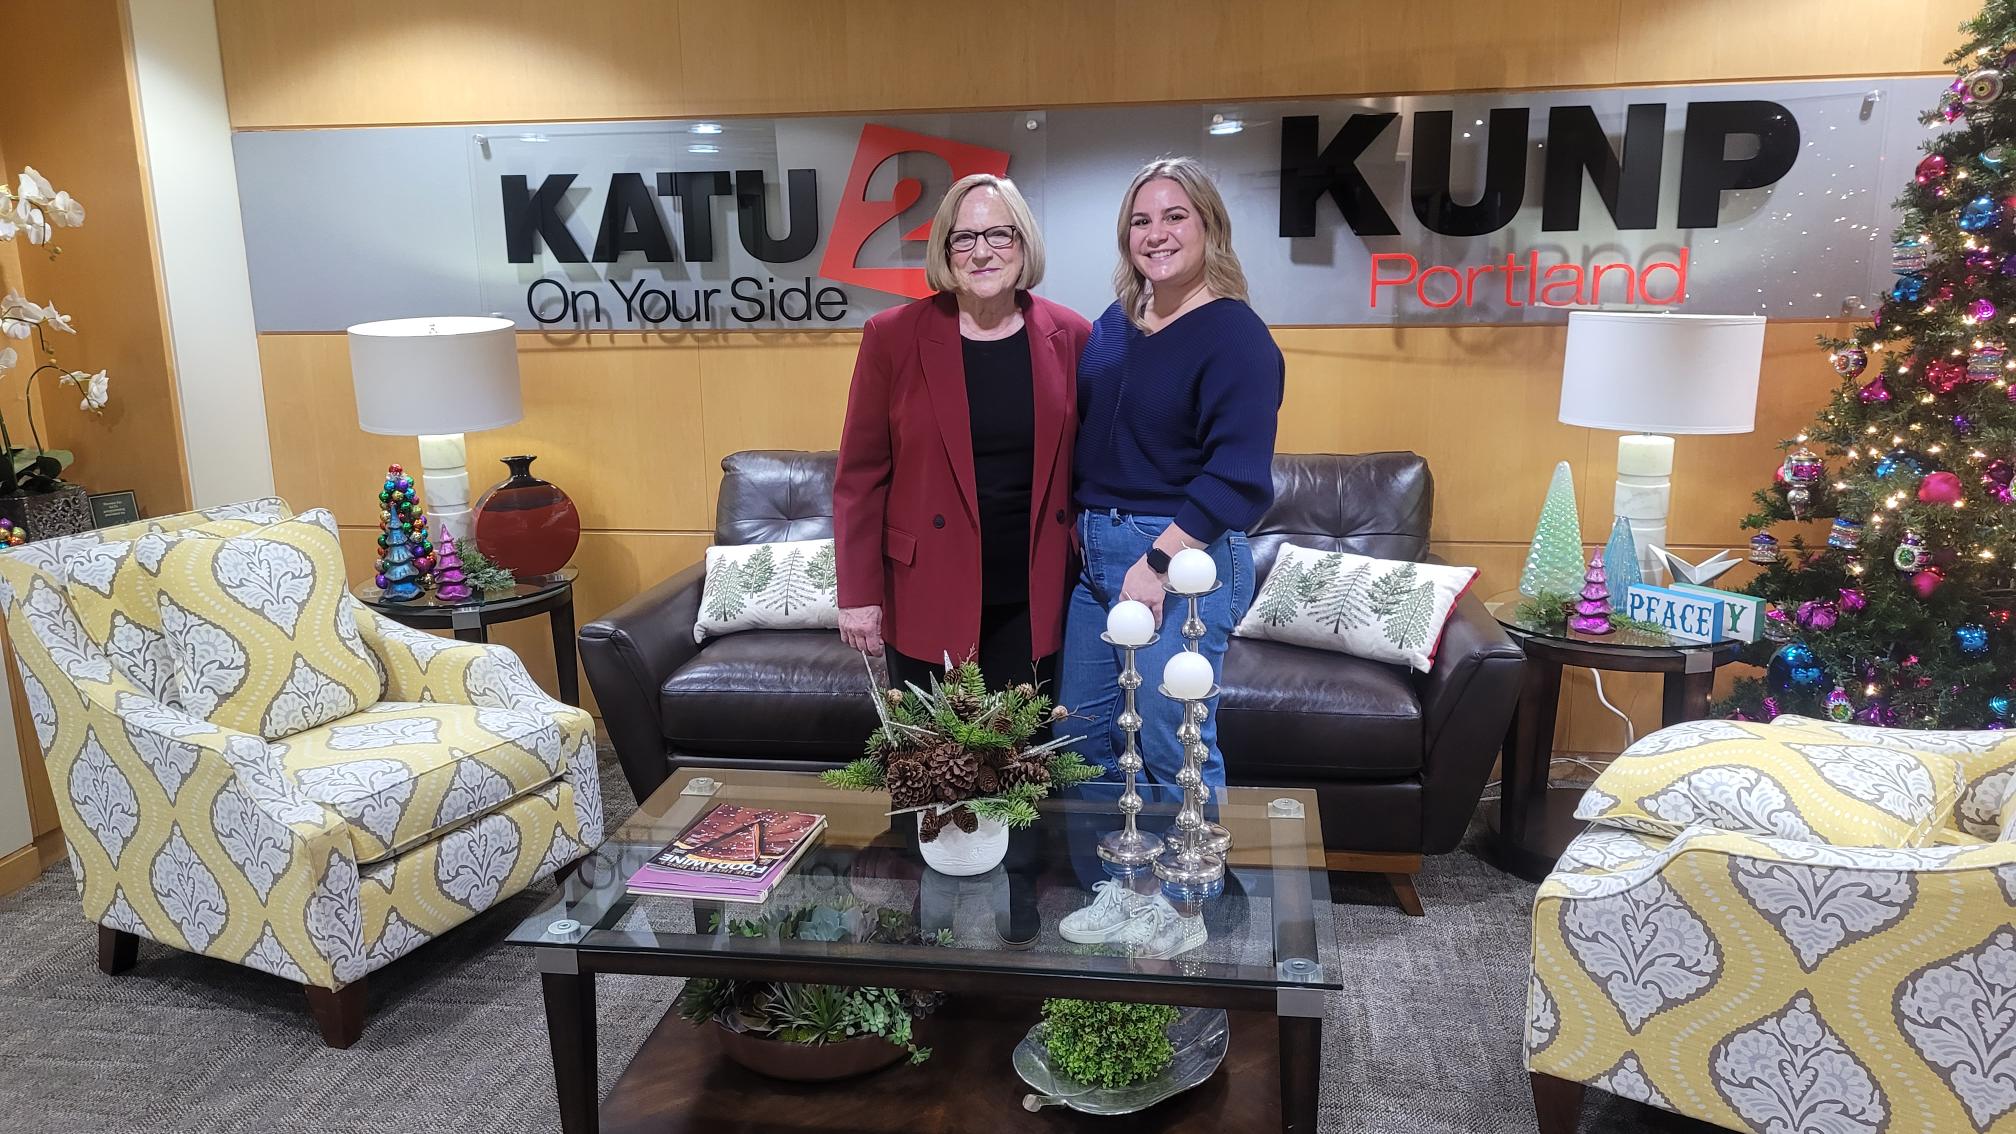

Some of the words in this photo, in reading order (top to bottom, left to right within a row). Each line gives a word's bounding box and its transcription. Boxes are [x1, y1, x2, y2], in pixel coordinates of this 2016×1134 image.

[1279, 100, 1800, 237] KUNP
[500, 169, 819, 264] KATU
[527, 278, 601, 323] On
[609, 278, 721, 323] Your
[730, 276, 848, 322] Side
[1369, 247, 1689, 308] Portland
[1630, 593, 1711, 636] PEACE
